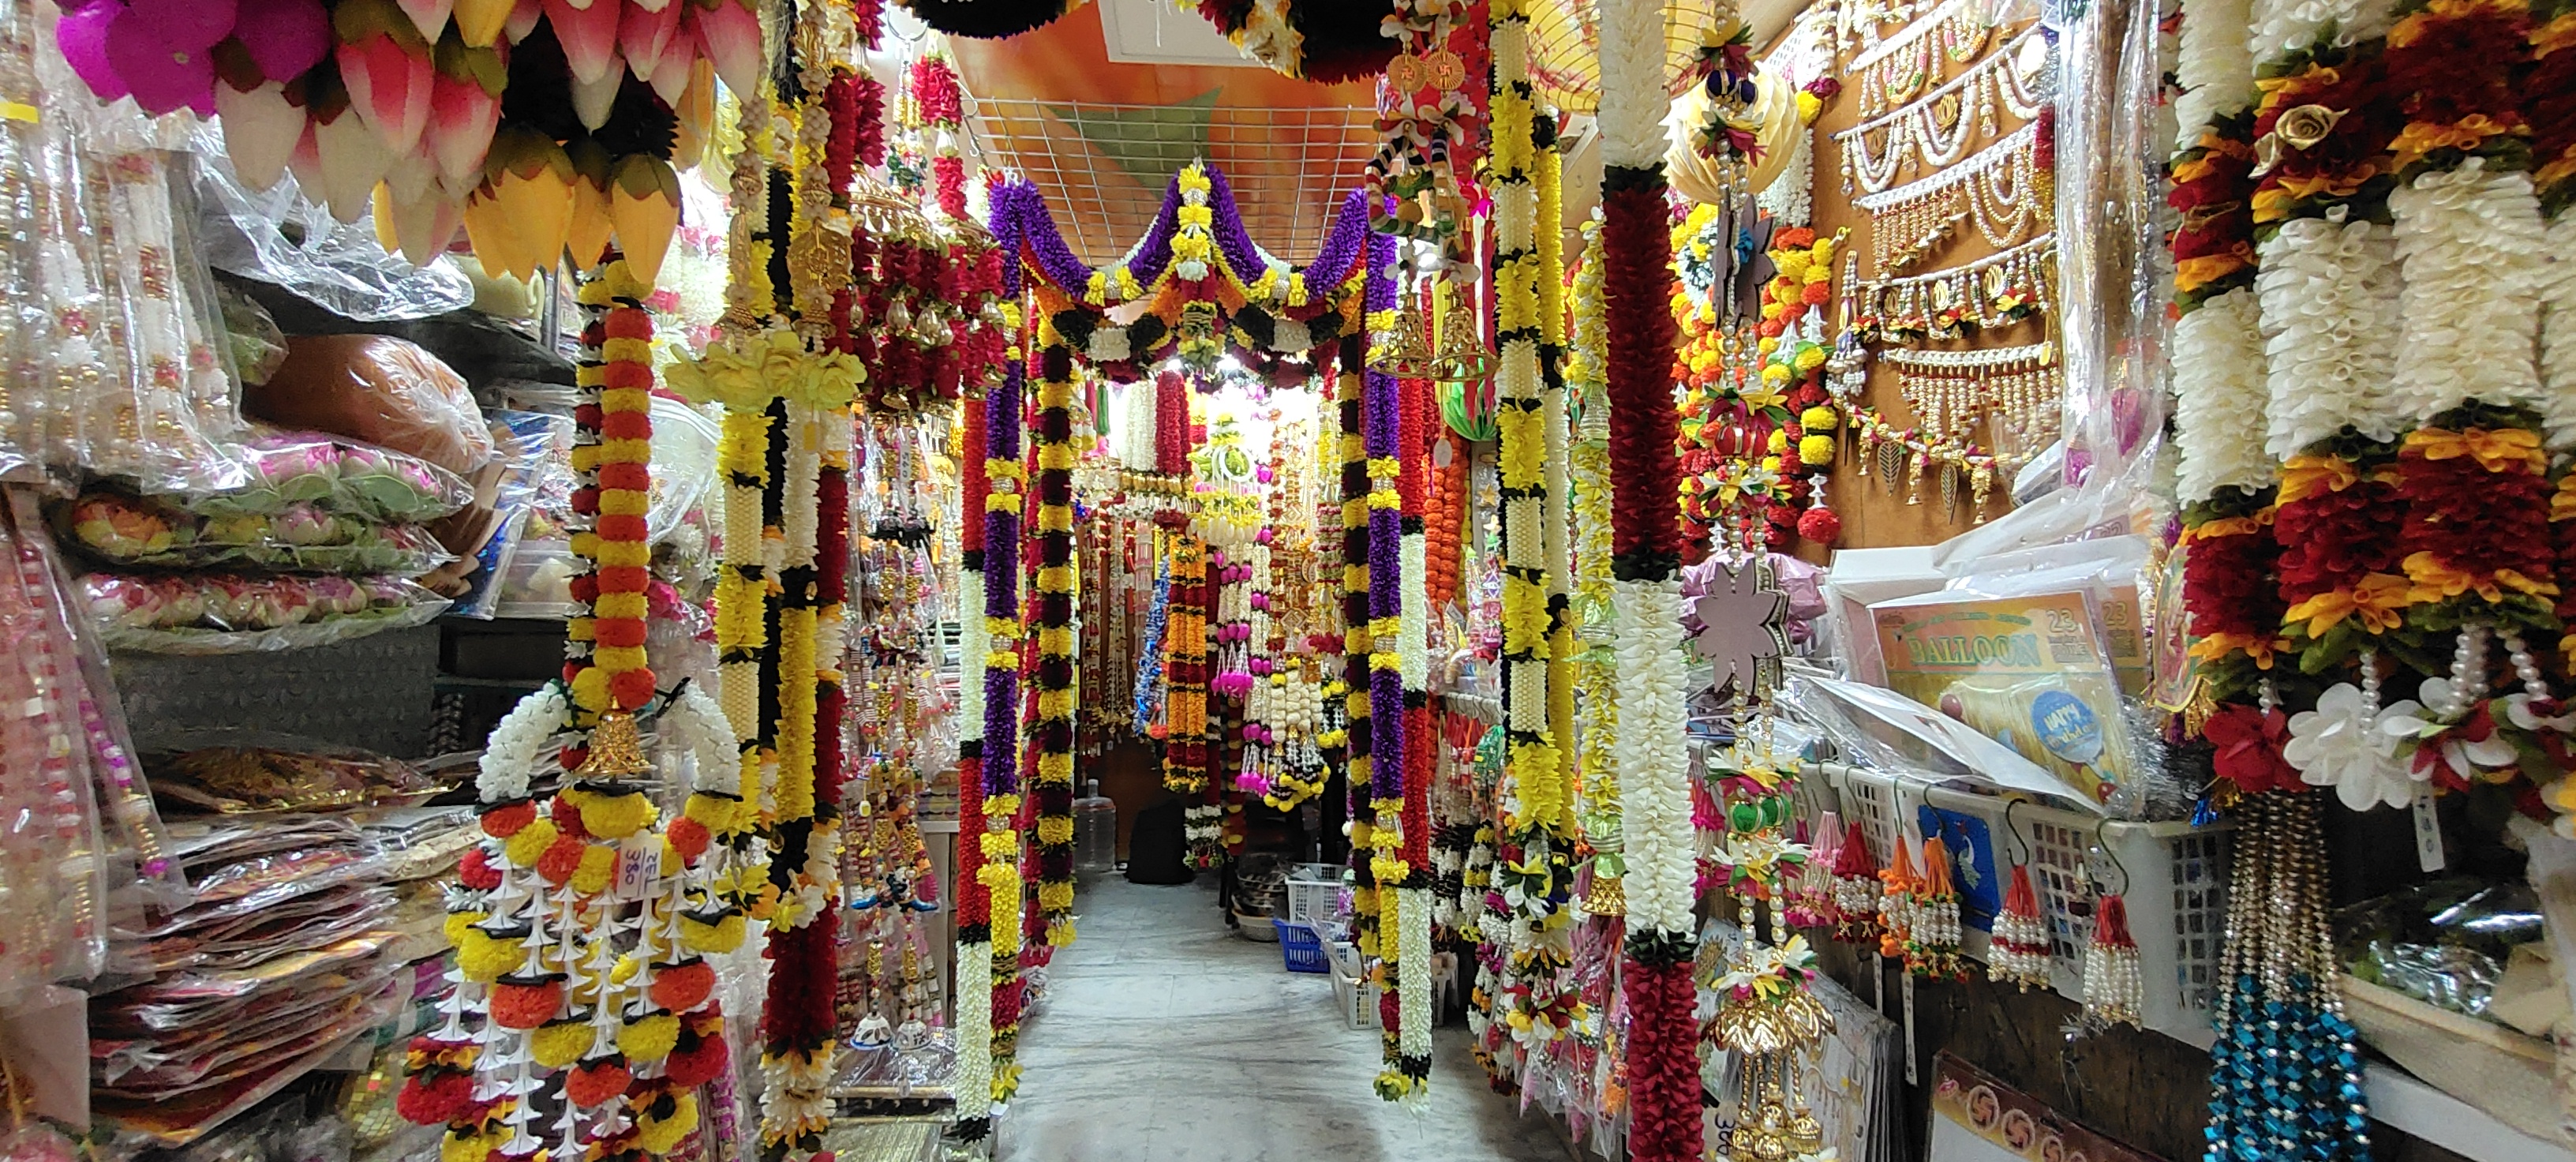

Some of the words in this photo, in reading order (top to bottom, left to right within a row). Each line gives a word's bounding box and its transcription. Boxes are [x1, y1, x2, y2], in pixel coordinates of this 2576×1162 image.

[2047, 606, 2077, 634] 23
[2102, 602, 2129, 626] 23
[1906, 634, 2042, 667] BALLOON
[644, 852, 659, 894] NET
